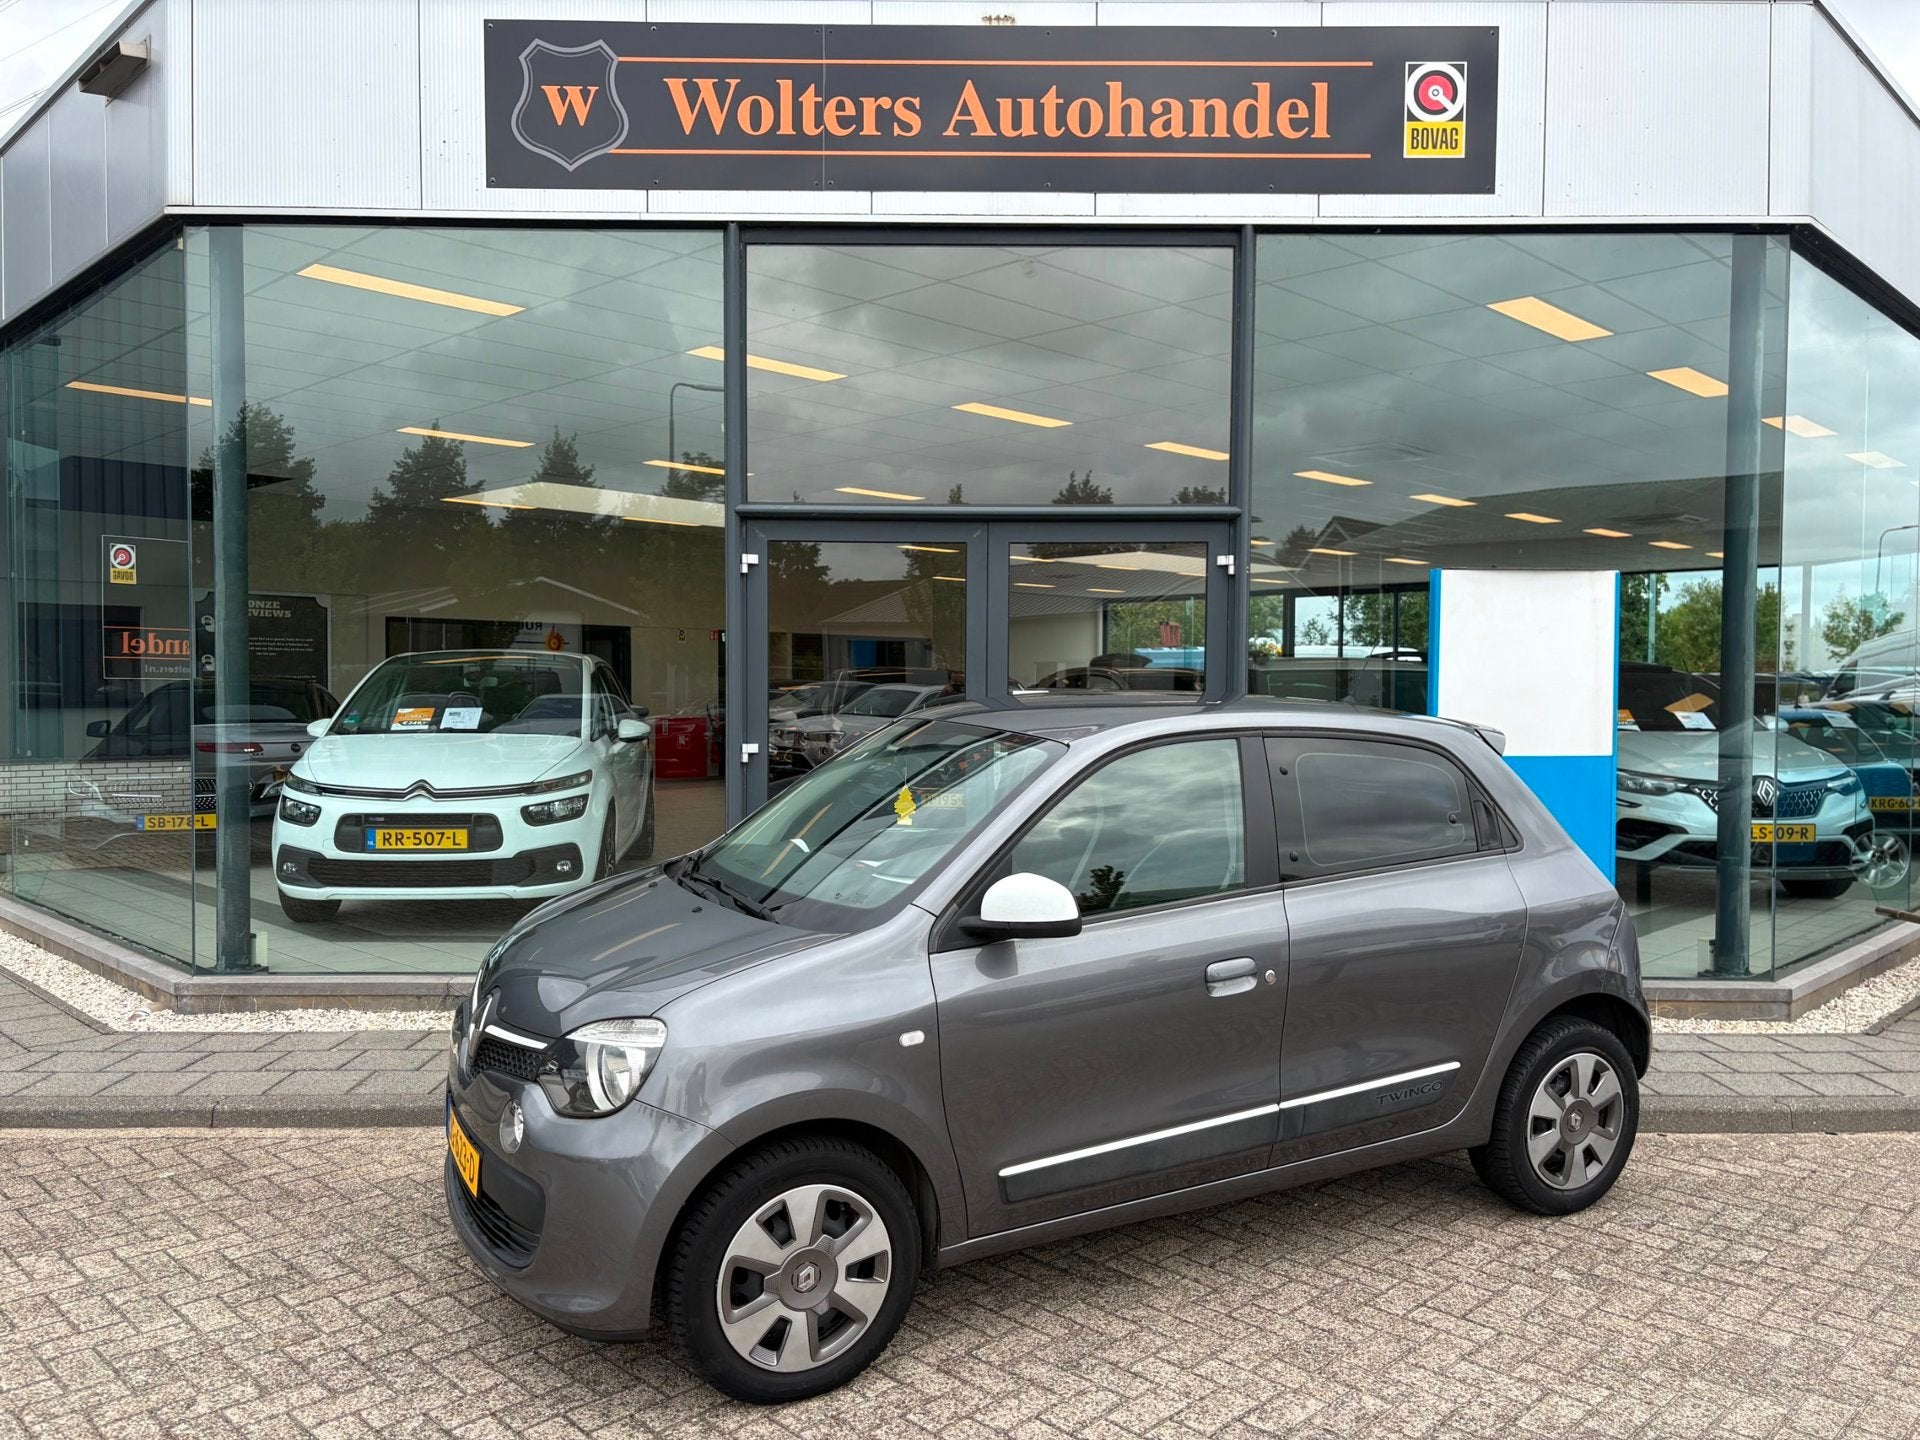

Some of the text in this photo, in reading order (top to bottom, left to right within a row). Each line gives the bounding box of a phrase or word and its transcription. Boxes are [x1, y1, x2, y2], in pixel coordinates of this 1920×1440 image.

[541, 86, 599, 127] W
[663, 78, 1331, 139] Wolters Autohandel
[1410, 127, 1459, 151] BOVAG
[248, 600, 281, 609] ONZE
[382, 831, 462, 847] RR-507-L
[1376, 1081, 1443, 1105] TWINGO
